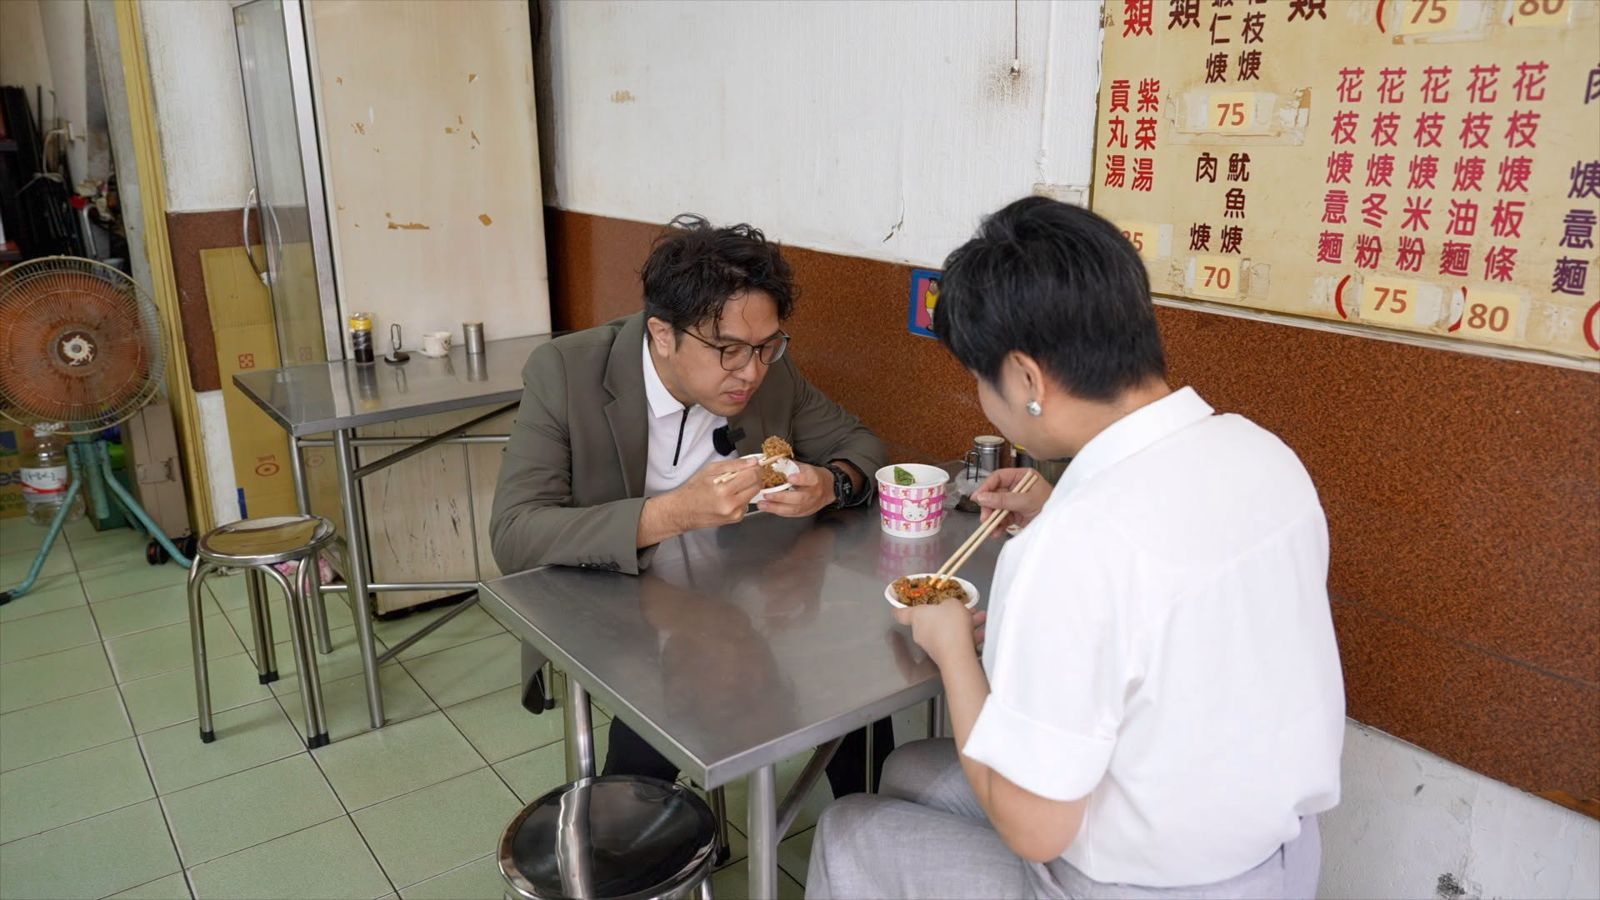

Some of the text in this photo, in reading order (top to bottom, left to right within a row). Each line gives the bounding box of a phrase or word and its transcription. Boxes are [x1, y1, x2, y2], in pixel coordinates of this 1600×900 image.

[1204, 0, 1234, 84] 仁焿
[1237, 0, 1268, 82] 枝焿
[1411, 0, 1448, 25] 75
[1104, 79, 1131, 189] 貢丸湯
[1131, 77, 1161, 192] 紫菜湯
[1216, 102, 1245, 127] 75
[1316, 66, 1365, 265] 花枝焿意麵
[1219, 152, 1251, 255] 魷魚焿
[1354, 67, 1407, 270] 花枝焿冬粉
[1395, 65, 1453, 273] 花枝焿米粉
[1438, 64, 1501, 277] 花枝焿油麵
[1484, 61, 1549, 283] 花枝焿板條
[1203, 265, 1231, 290] 70
[1373, 286, 1408, 314] 75
[1466, 302, 1510, 333] 80
